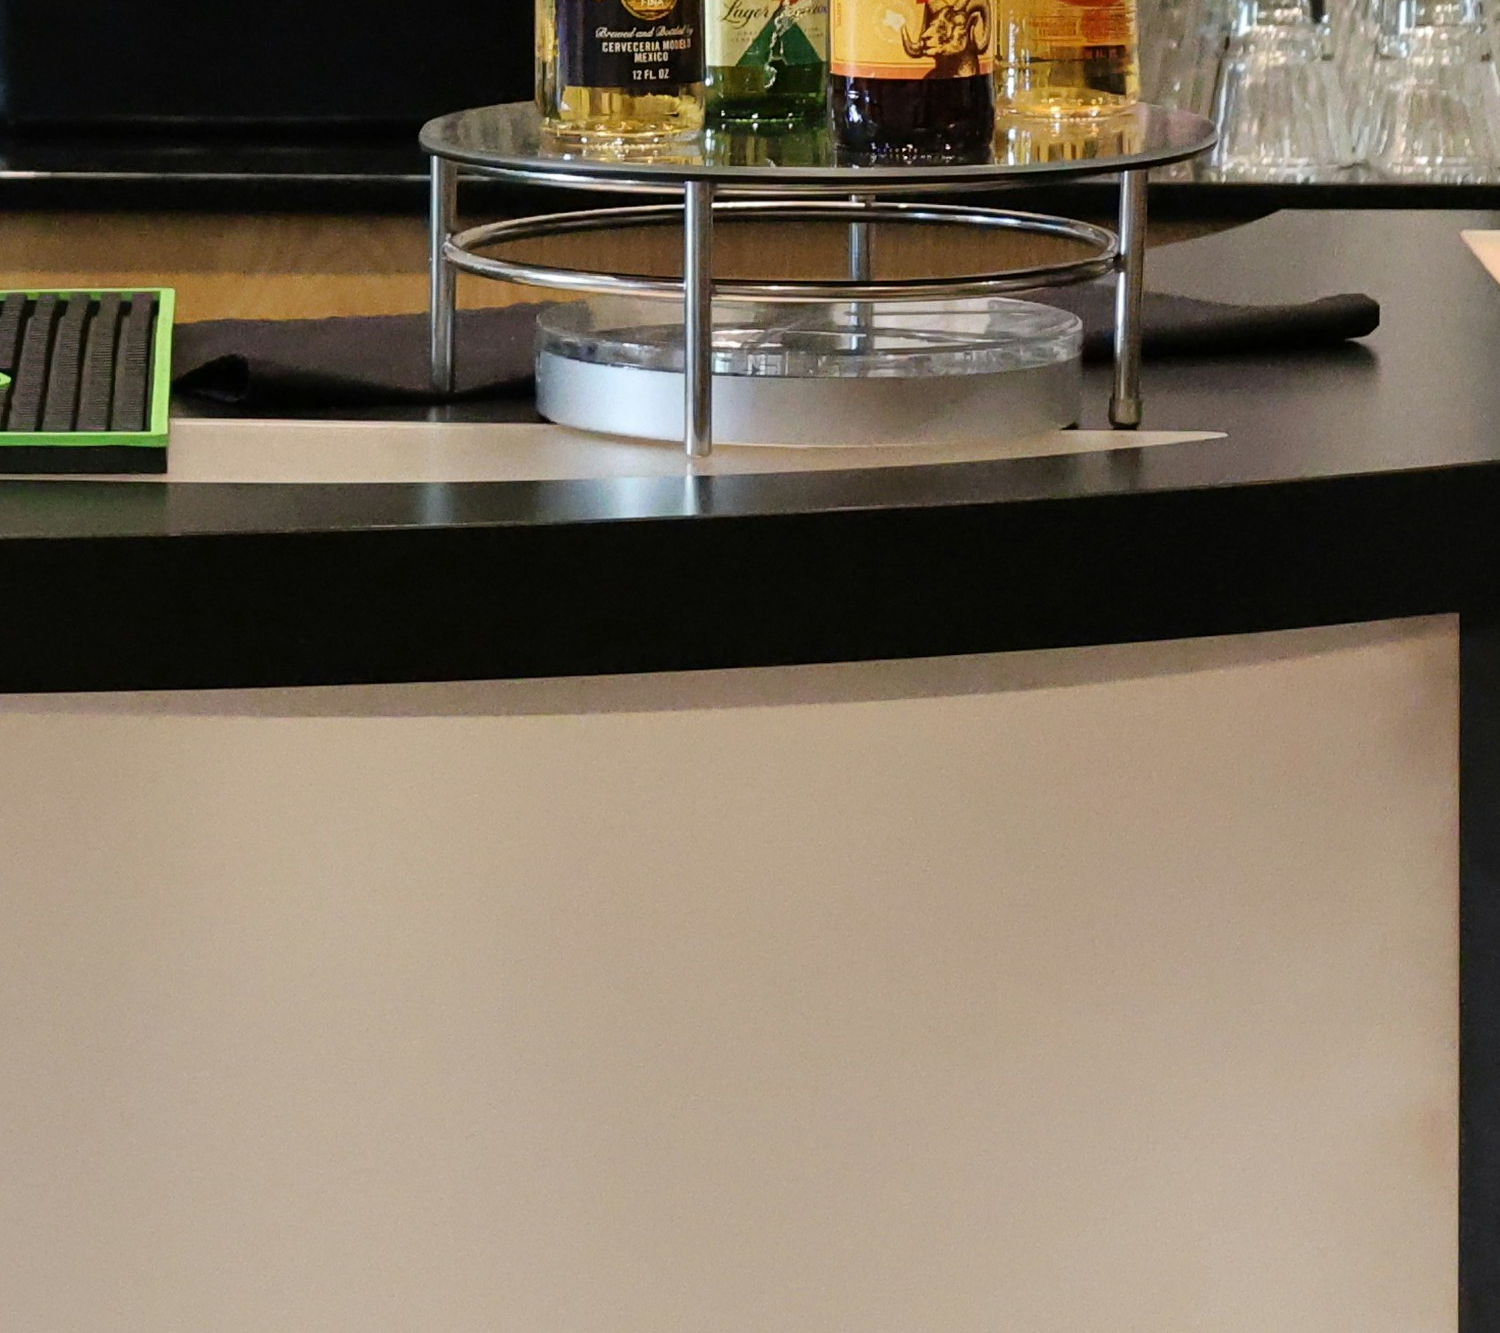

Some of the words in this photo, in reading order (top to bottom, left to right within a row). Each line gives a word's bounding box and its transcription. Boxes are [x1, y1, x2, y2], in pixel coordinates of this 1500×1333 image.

[602, 42, 661, 53] CERVECERIA
[634, 52, 669, 64] MEXICO
[632, 70, 643, 81] 12
[658, 68, 670, 80] OZ
